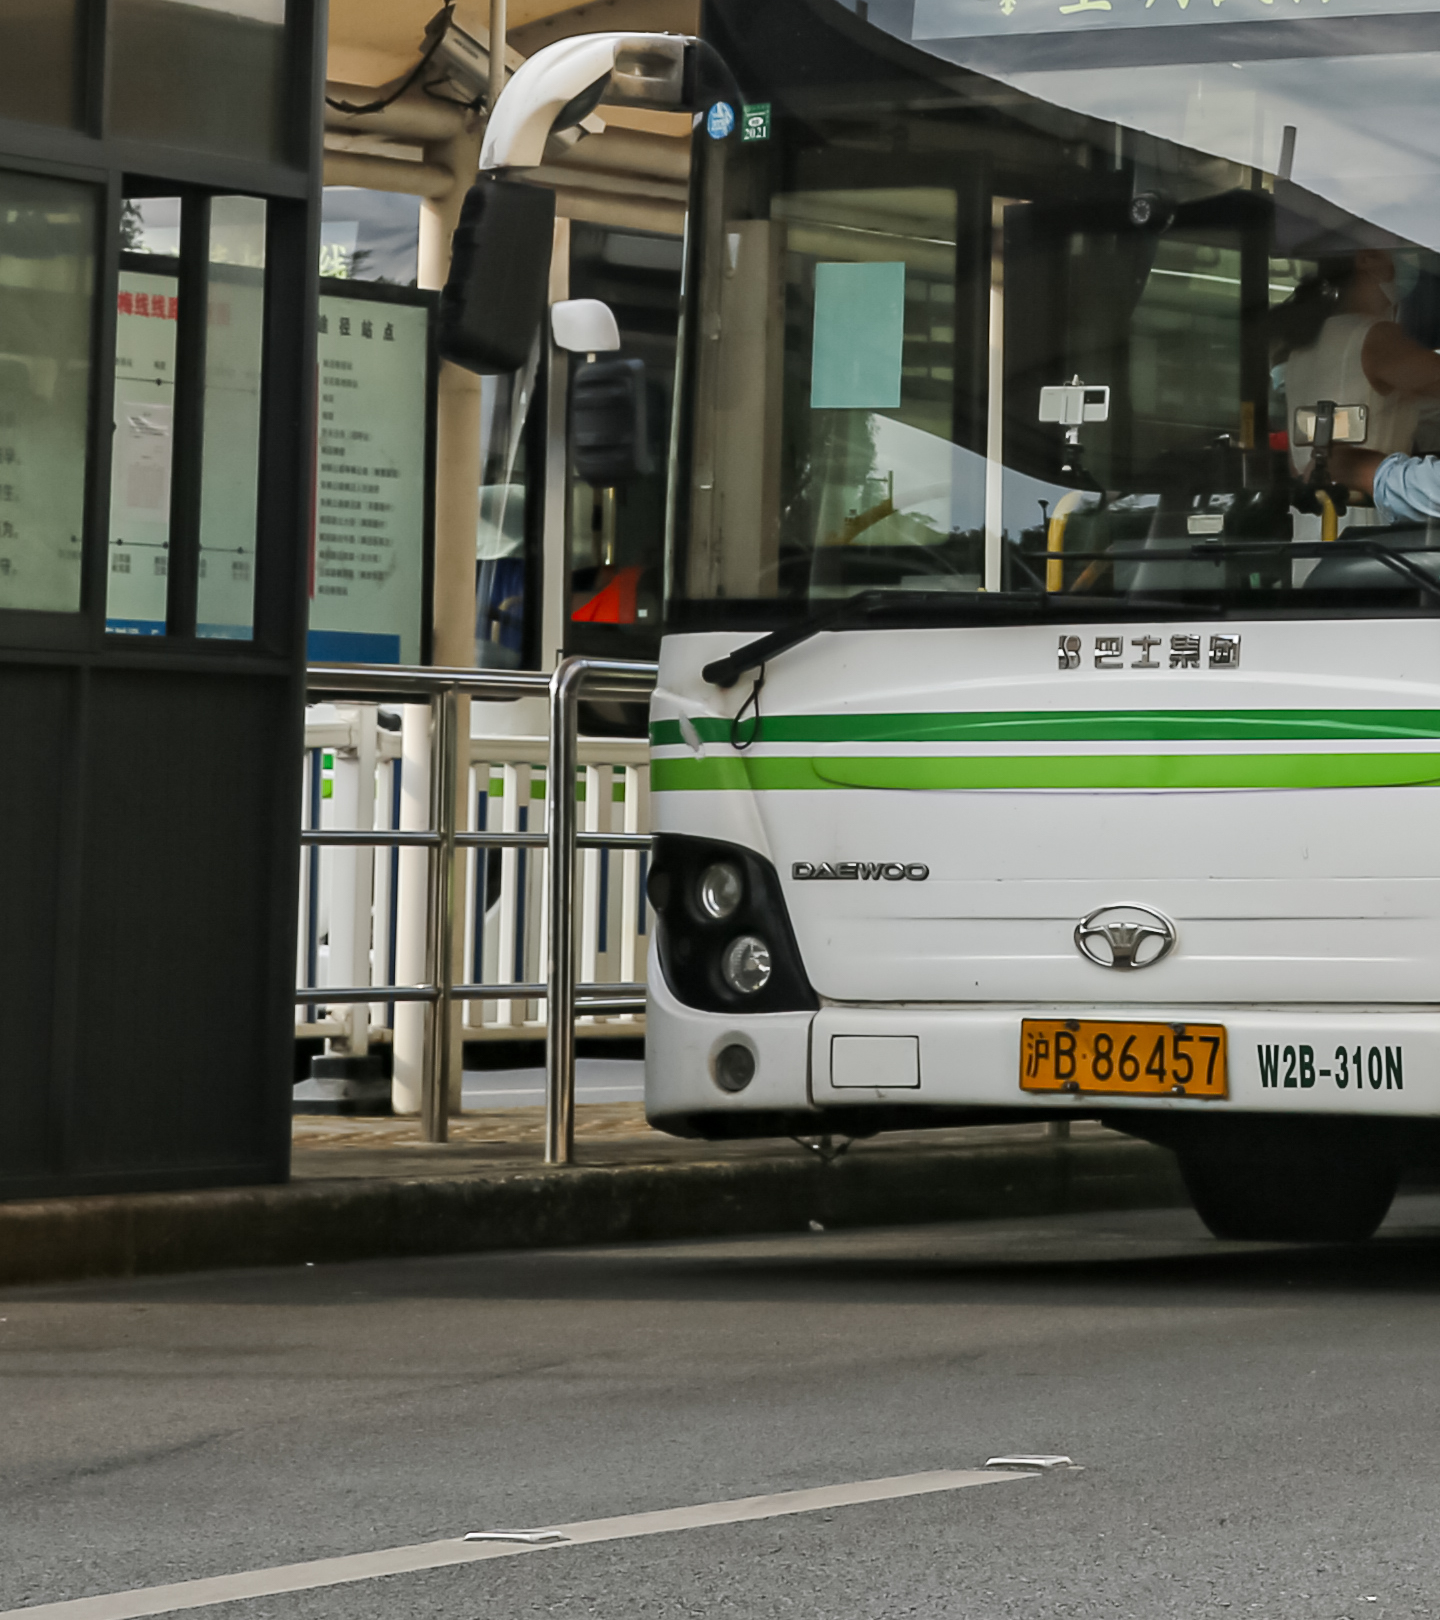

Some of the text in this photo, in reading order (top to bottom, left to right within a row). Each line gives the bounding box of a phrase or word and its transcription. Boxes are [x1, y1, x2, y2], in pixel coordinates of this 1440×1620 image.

[743, 125, 767, 141] 2021
[1094, 633, 1242, 670] 巴士集团
[791, 861, 930, 882] DAEWOO
[1257, 1043, 1405, 1091] W2B-310N
